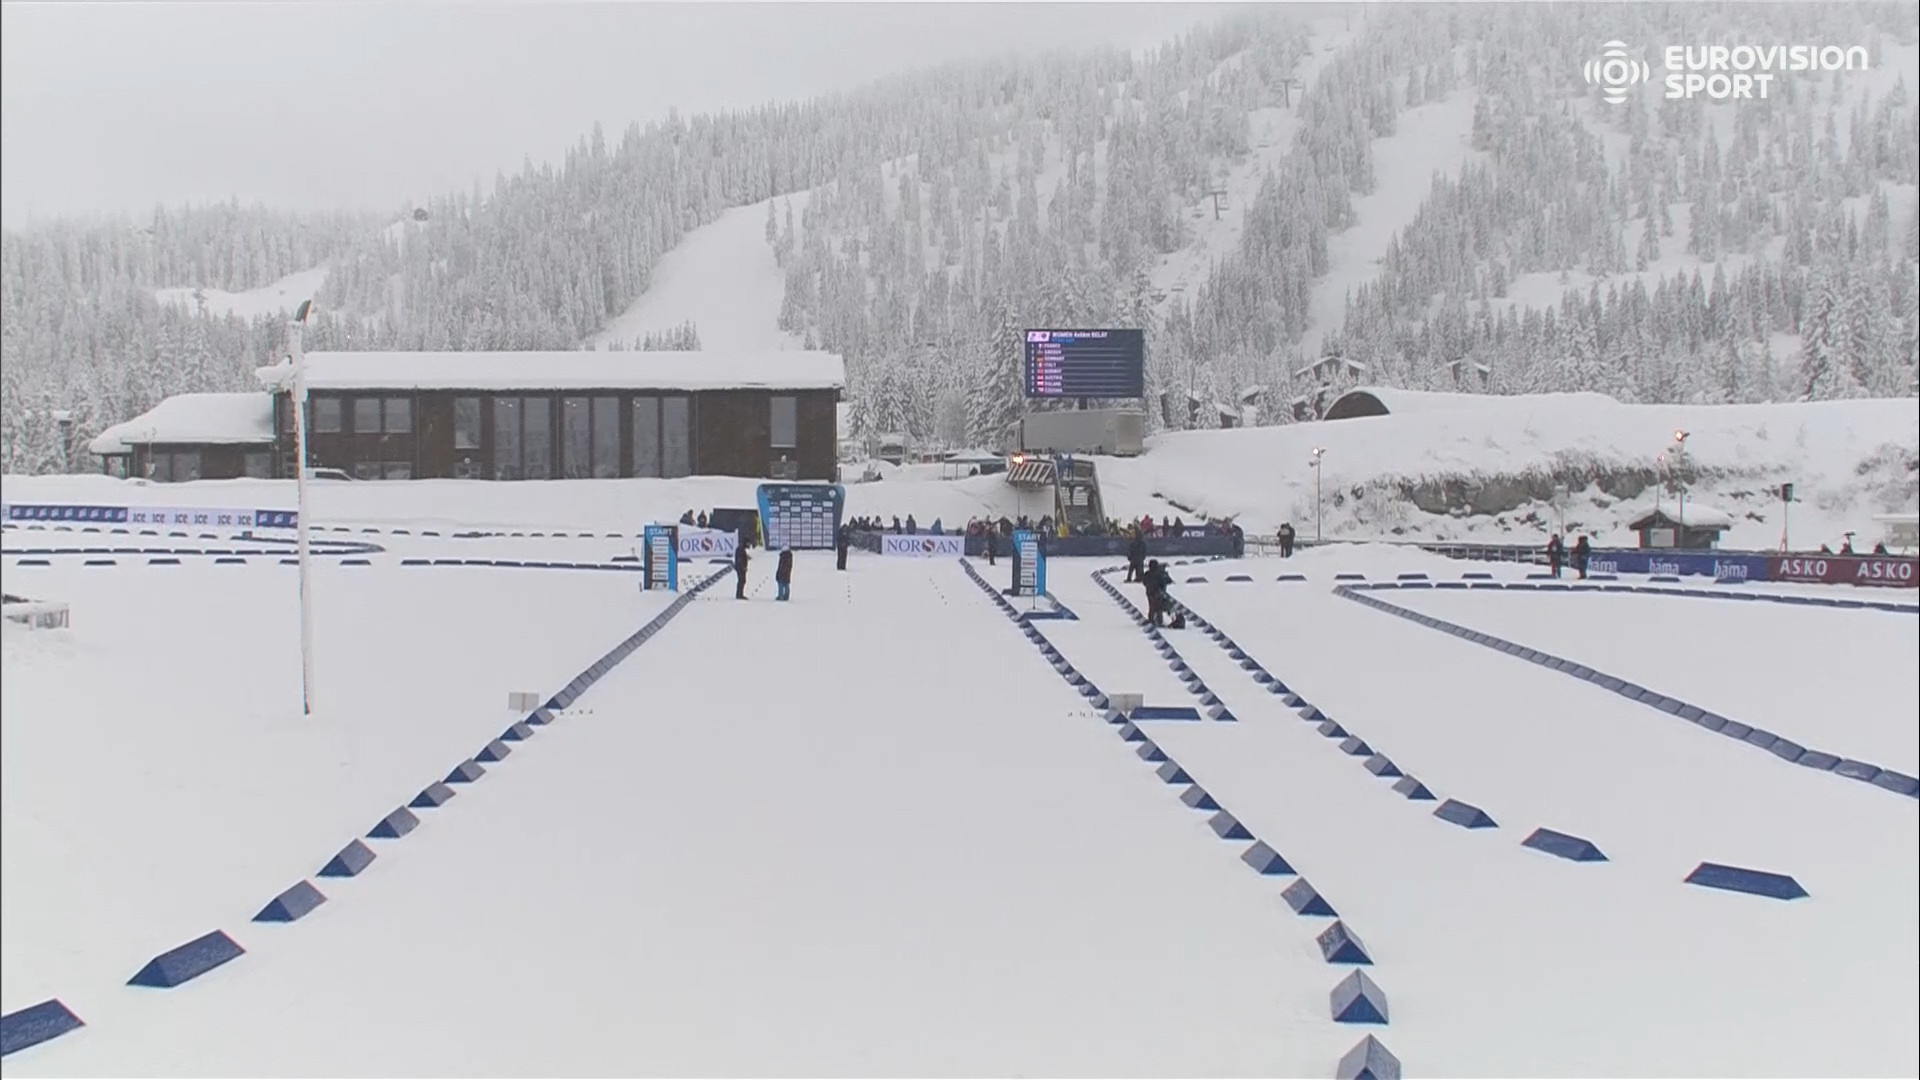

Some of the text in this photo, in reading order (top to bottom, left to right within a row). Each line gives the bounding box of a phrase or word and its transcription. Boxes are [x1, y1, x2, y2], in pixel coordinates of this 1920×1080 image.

[680, 537, 734, 553] ORSAN
[1018, 533, 1041, 541] START
[887, 539, 959, 553] NORSAN
[1649, 557, 1680, 575] bama
[1714, 559, 1748, 578] bama
[1780, 559, 1828, 576] ASKO
[1857, 561, 1912, 580] ASKO
